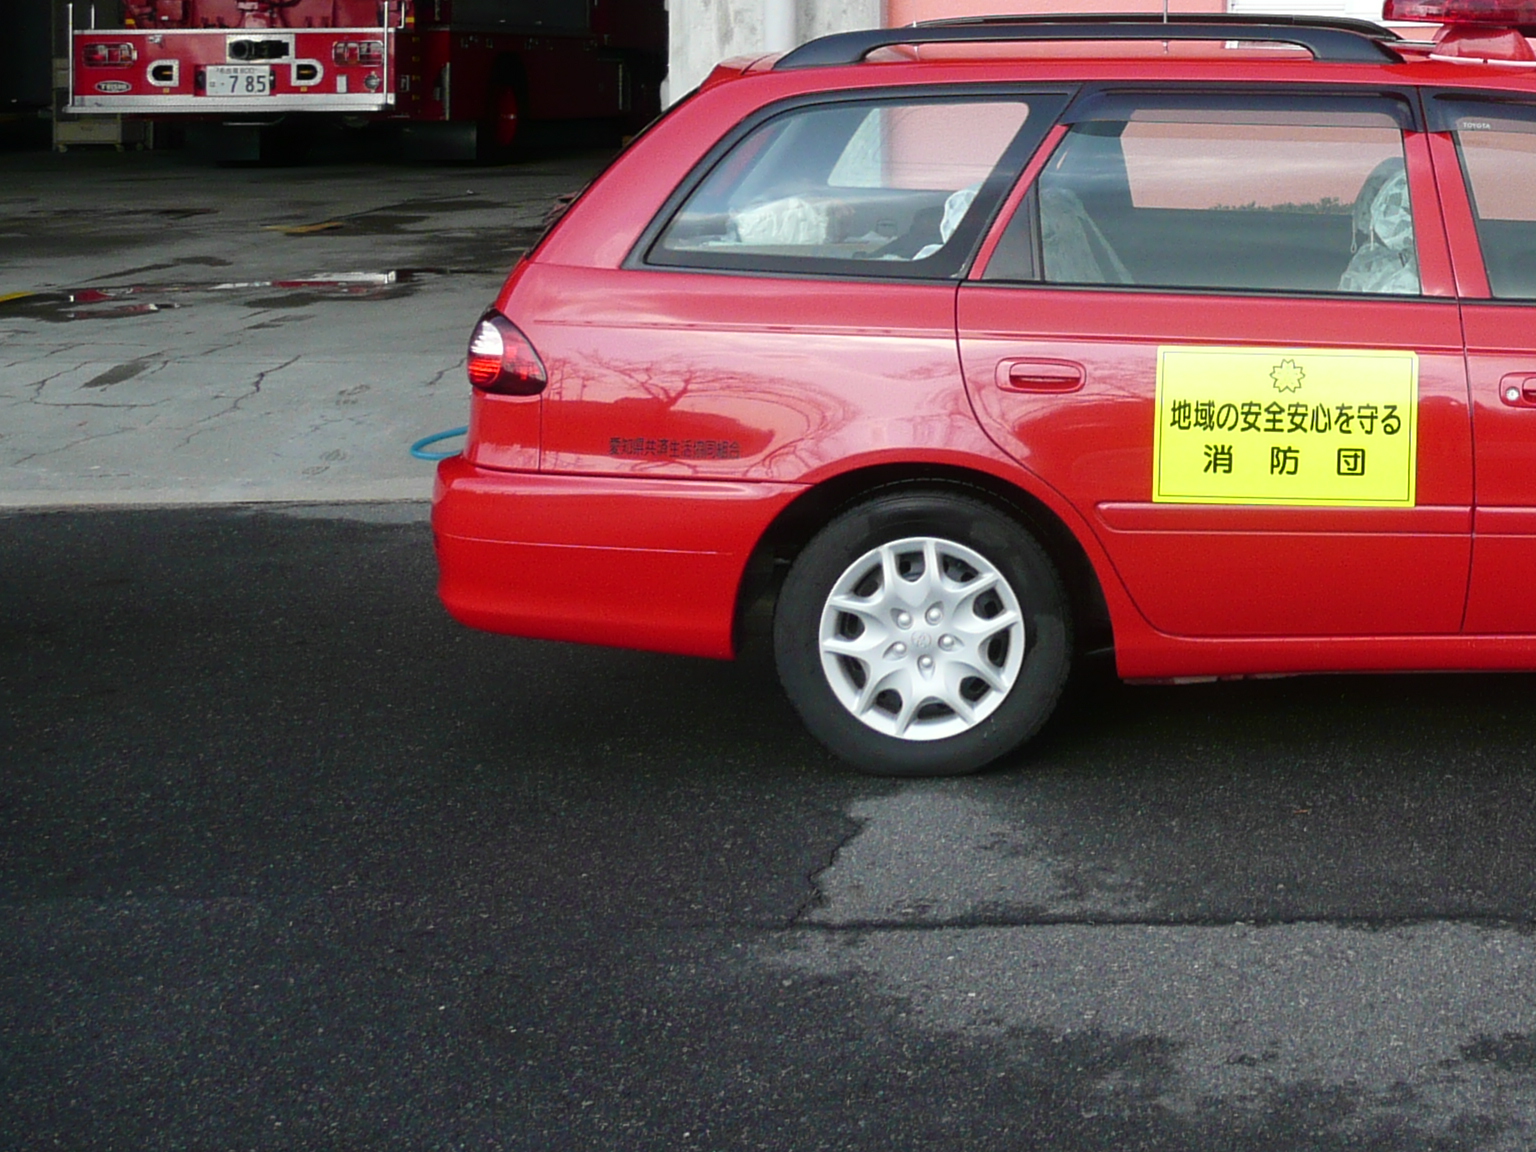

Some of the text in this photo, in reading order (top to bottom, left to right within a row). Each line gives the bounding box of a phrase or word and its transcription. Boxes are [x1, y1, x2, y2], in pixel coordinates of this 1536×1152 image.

[1462, 121, 1491, 130] TOYOTA
[1168, 399, 1403, 436] 地域の安全安心を守る
